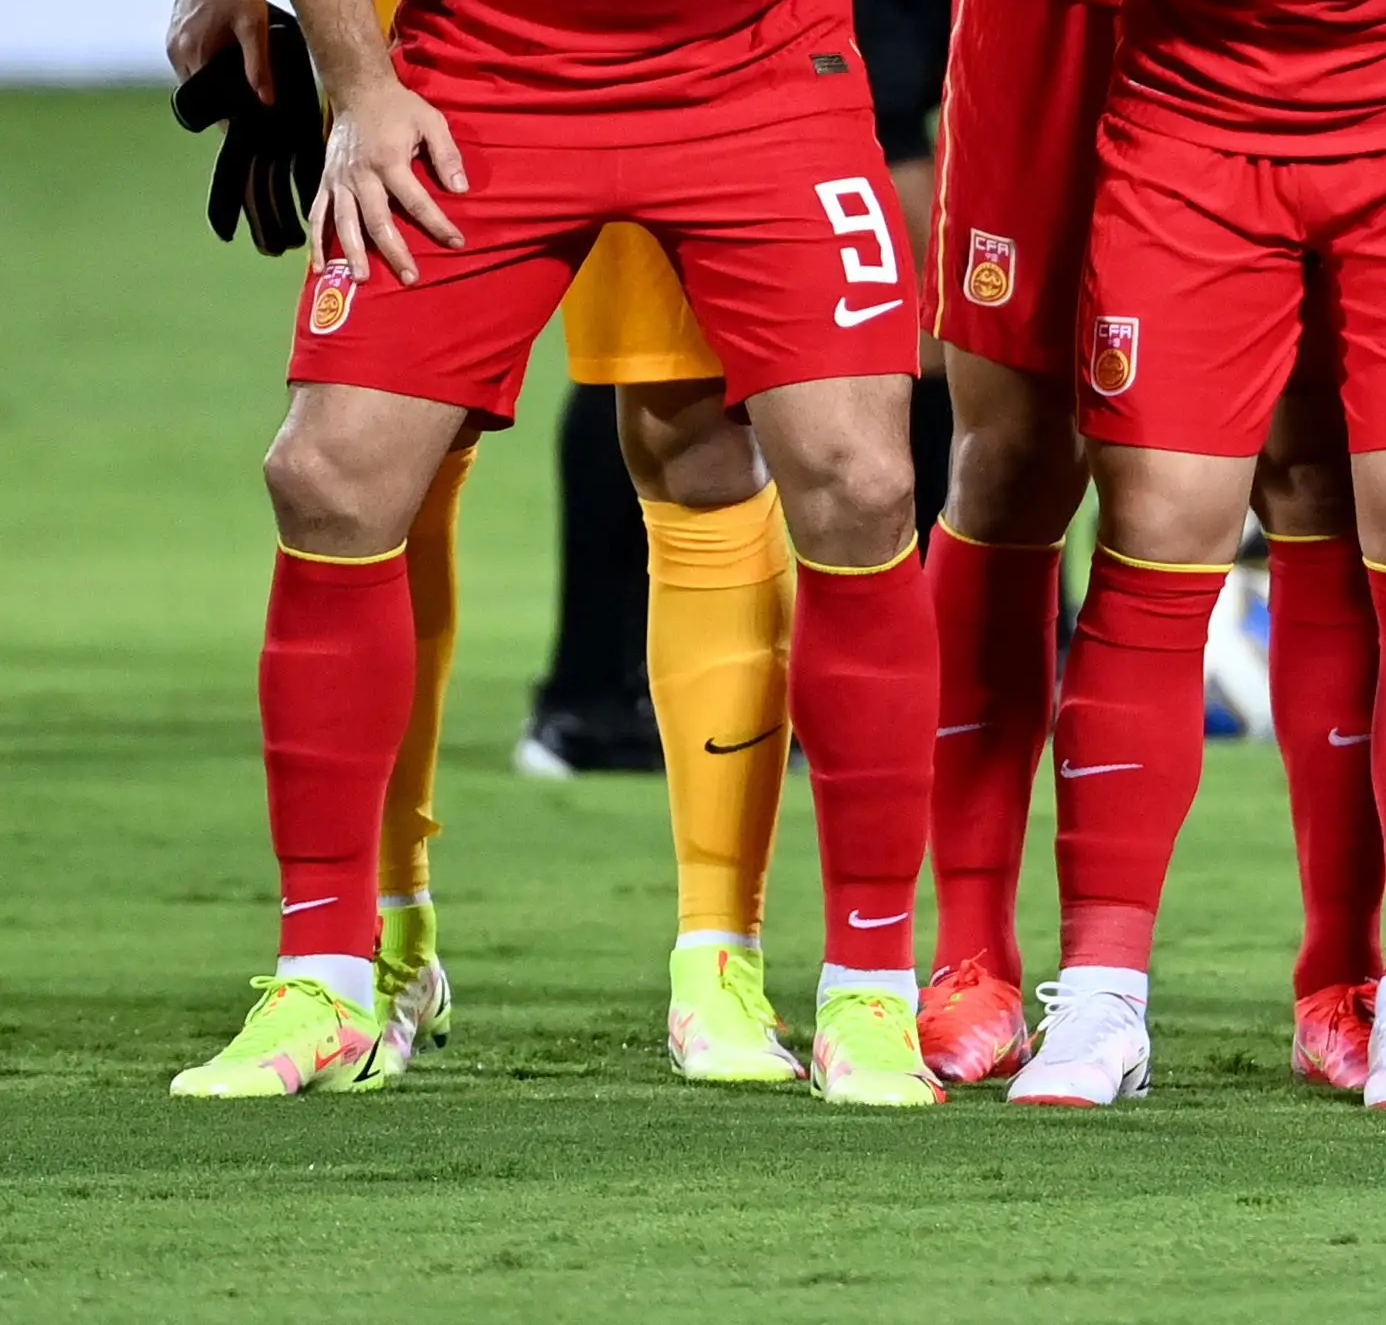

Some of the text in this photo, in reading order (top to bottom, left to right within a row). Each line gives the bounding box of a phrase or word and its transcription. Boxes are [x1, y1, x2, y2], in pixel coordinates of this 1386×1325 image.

[815, 176, 898, 284] 9
[974, 237, 1009, 255] CFA
[1098, 324, 1132, 340] CFA
